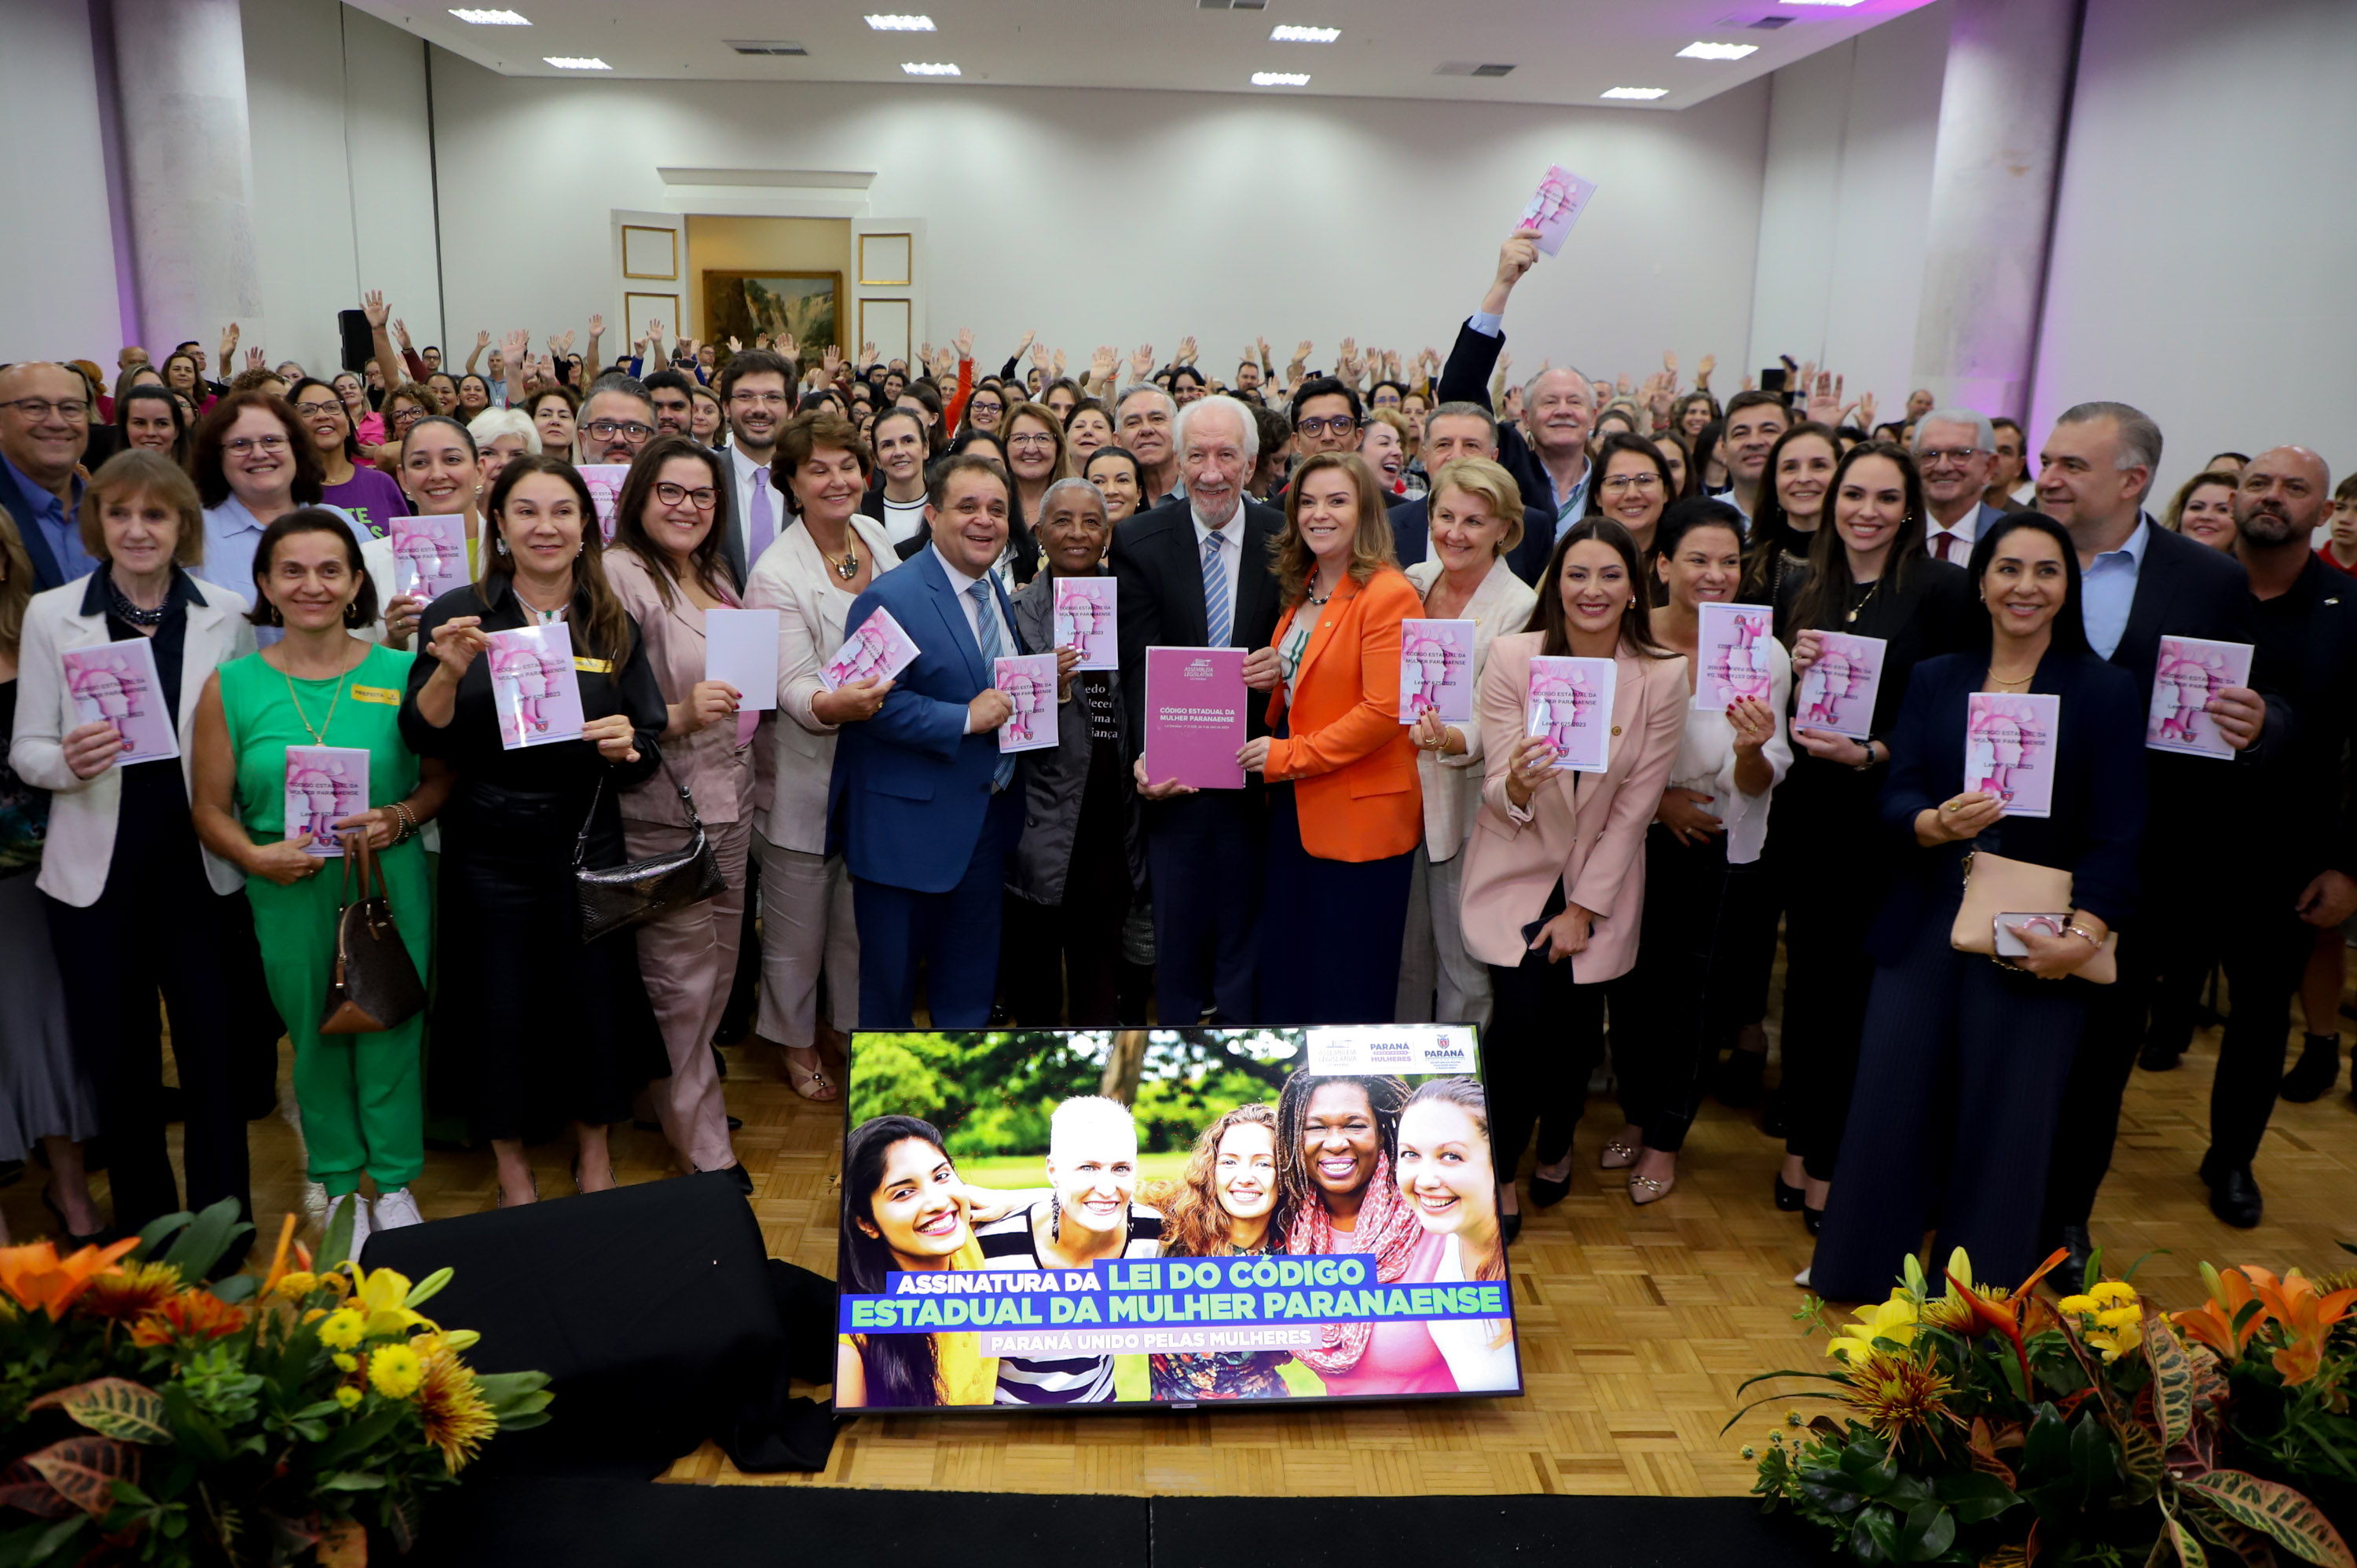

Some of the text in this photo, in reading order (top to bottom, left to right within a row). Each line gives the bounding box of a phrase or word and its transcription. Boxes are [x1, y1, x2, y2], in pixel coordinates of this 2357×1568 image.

[1370, 1042, 1409, 1050] PARANÁ
[1424, 1048, 1464, 1057] PARANÁ
[896, 1255, 1365, 1294] ASSINATURA DA LEI DO CÓDIGO
[852, 1286, 1503, 1327] ESTADUAL DA MULHER PARANAENSE
[991, 1329, 1312, 1351] PARANÁ UNIDO PELAS MULHERES
